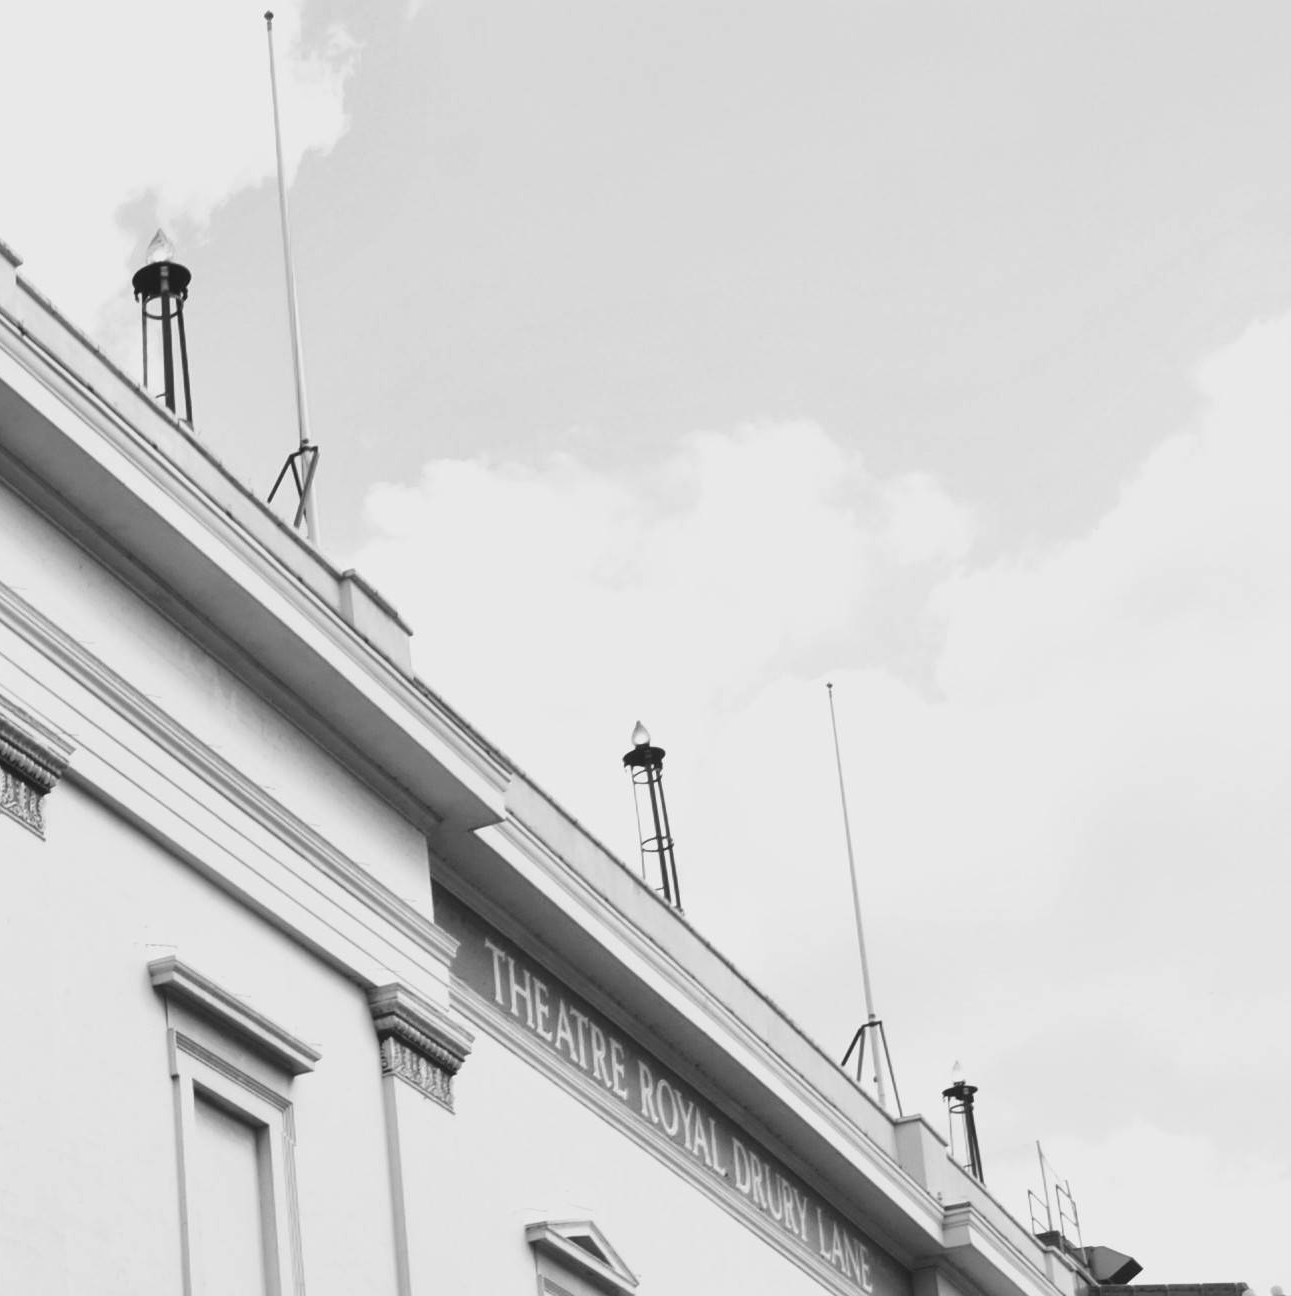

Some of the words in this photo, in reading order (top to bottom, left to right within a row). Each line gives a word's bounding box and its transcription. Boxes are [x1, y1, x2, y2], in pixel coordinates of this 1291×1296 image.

[484, 937, 628, 1100] THEATRE
[637, 1060, 729, 1177] ROYAL
[732, 1137, 810, 1242] DRURY
[817, 1207, 874, 1294] LANE
